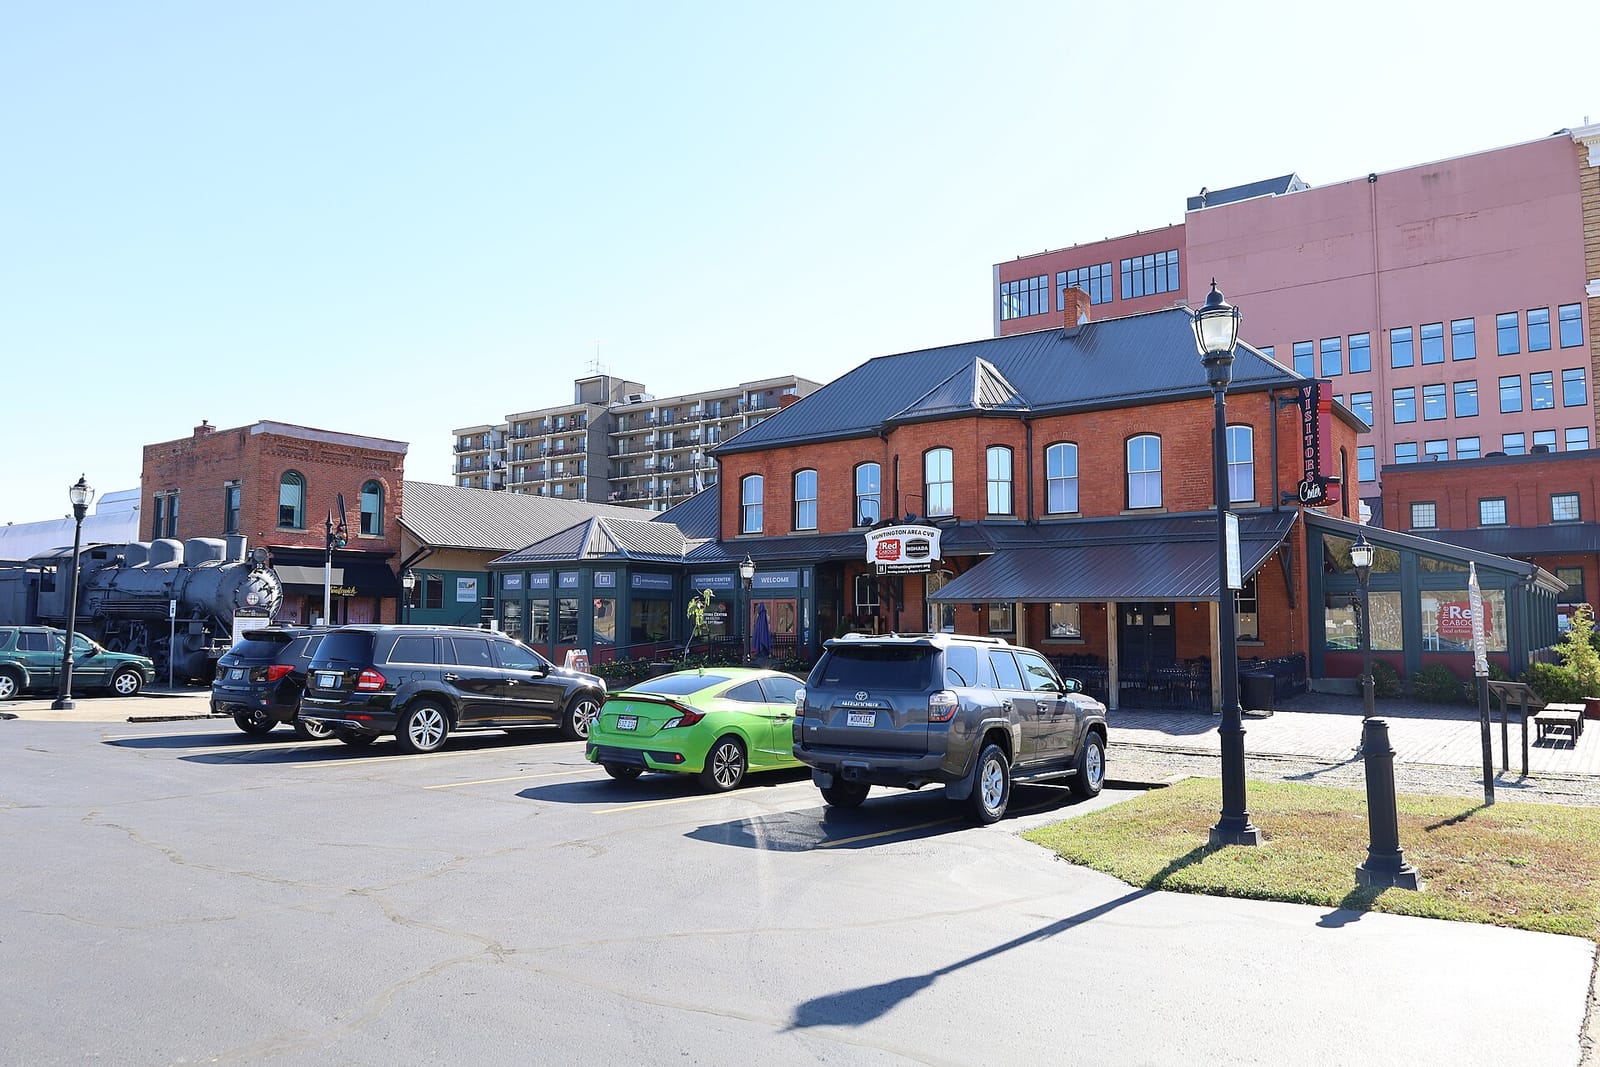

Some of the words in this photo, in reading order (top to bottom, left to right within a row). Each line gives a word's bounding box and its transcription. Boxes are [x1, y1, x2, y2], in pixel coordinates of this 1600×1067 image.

[1303, 386, 1315, 482] VISITORS
[1299, 481, 1321, 502] Center
[871, 529, 907, 540] HUNTINGTON
[922, 530, 935, 538] CVB
[882, 541, 898, 549] Red
